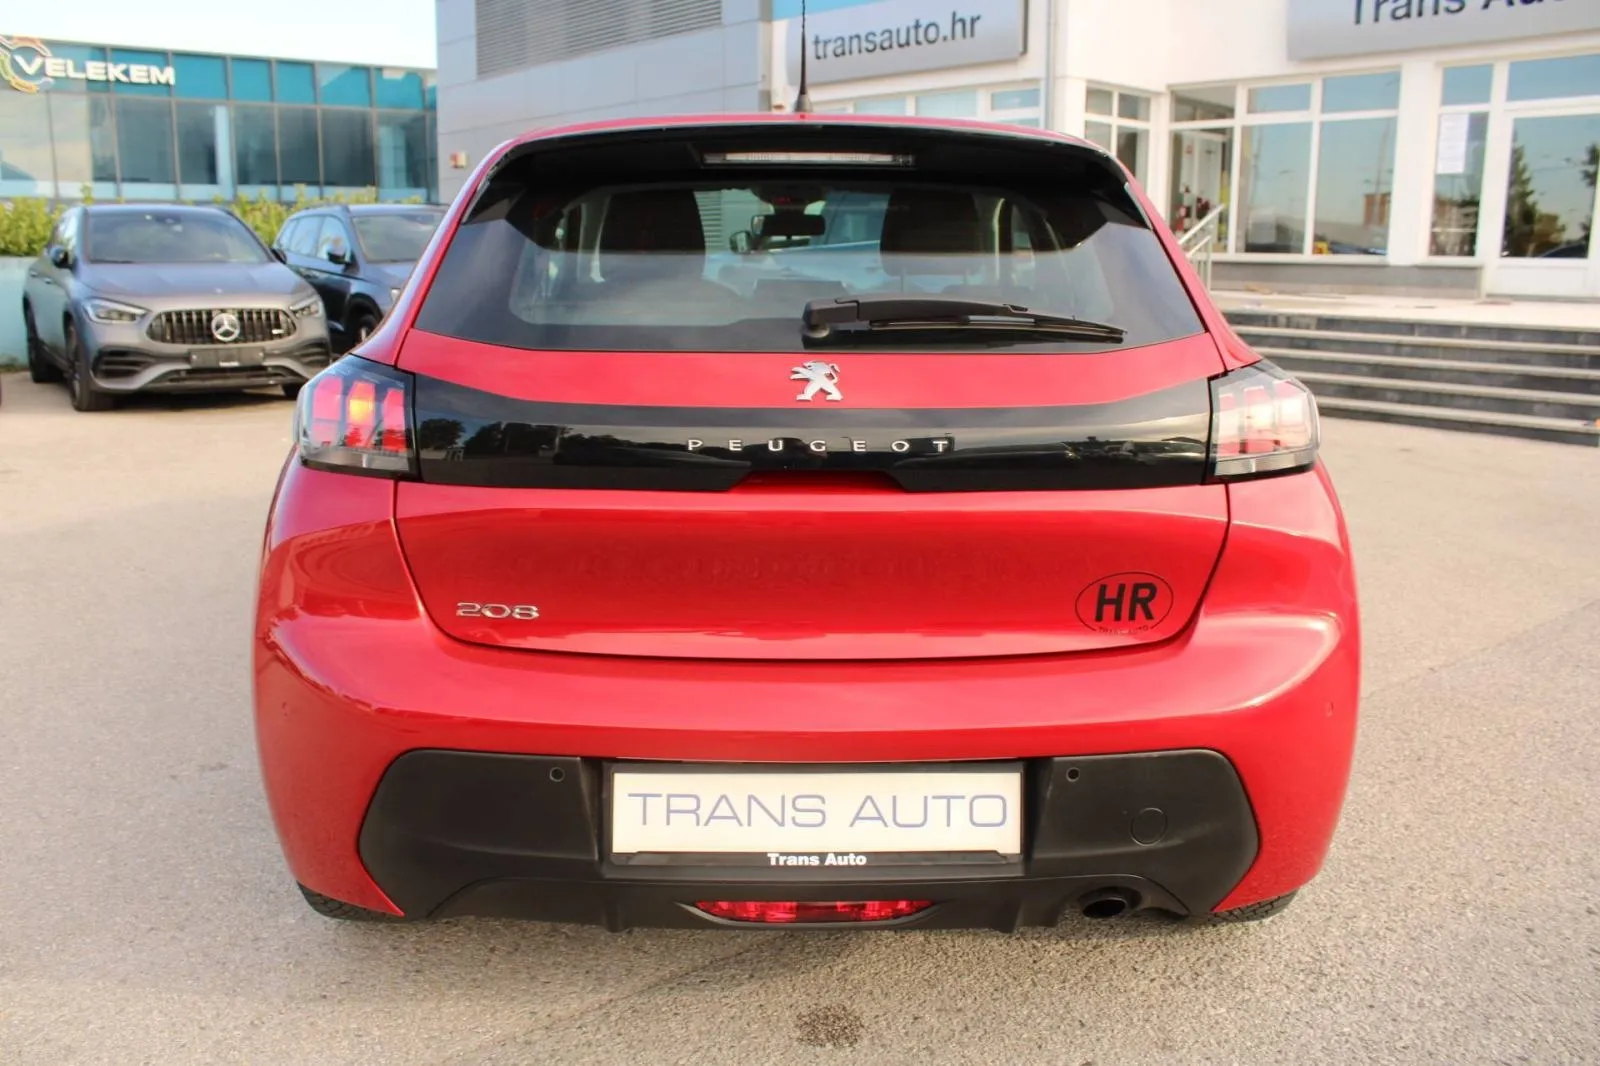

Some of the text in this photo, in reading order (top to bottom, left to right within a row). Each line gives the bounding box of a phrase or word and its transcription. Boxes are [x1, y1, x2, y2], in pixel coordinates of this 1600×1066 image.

[812, 11, 982, 60] transauto.hr
[13, 54, 176, 86] VELEKEM
[687, 439, 949, 453] PEUGEOT
[456, 602, 540, 621] 208
[1094, 582, 1158, 623] HR
[628, 793, 1008, 829] TRANS AUTO
[766, 852, 868, 867] Trans Auto
